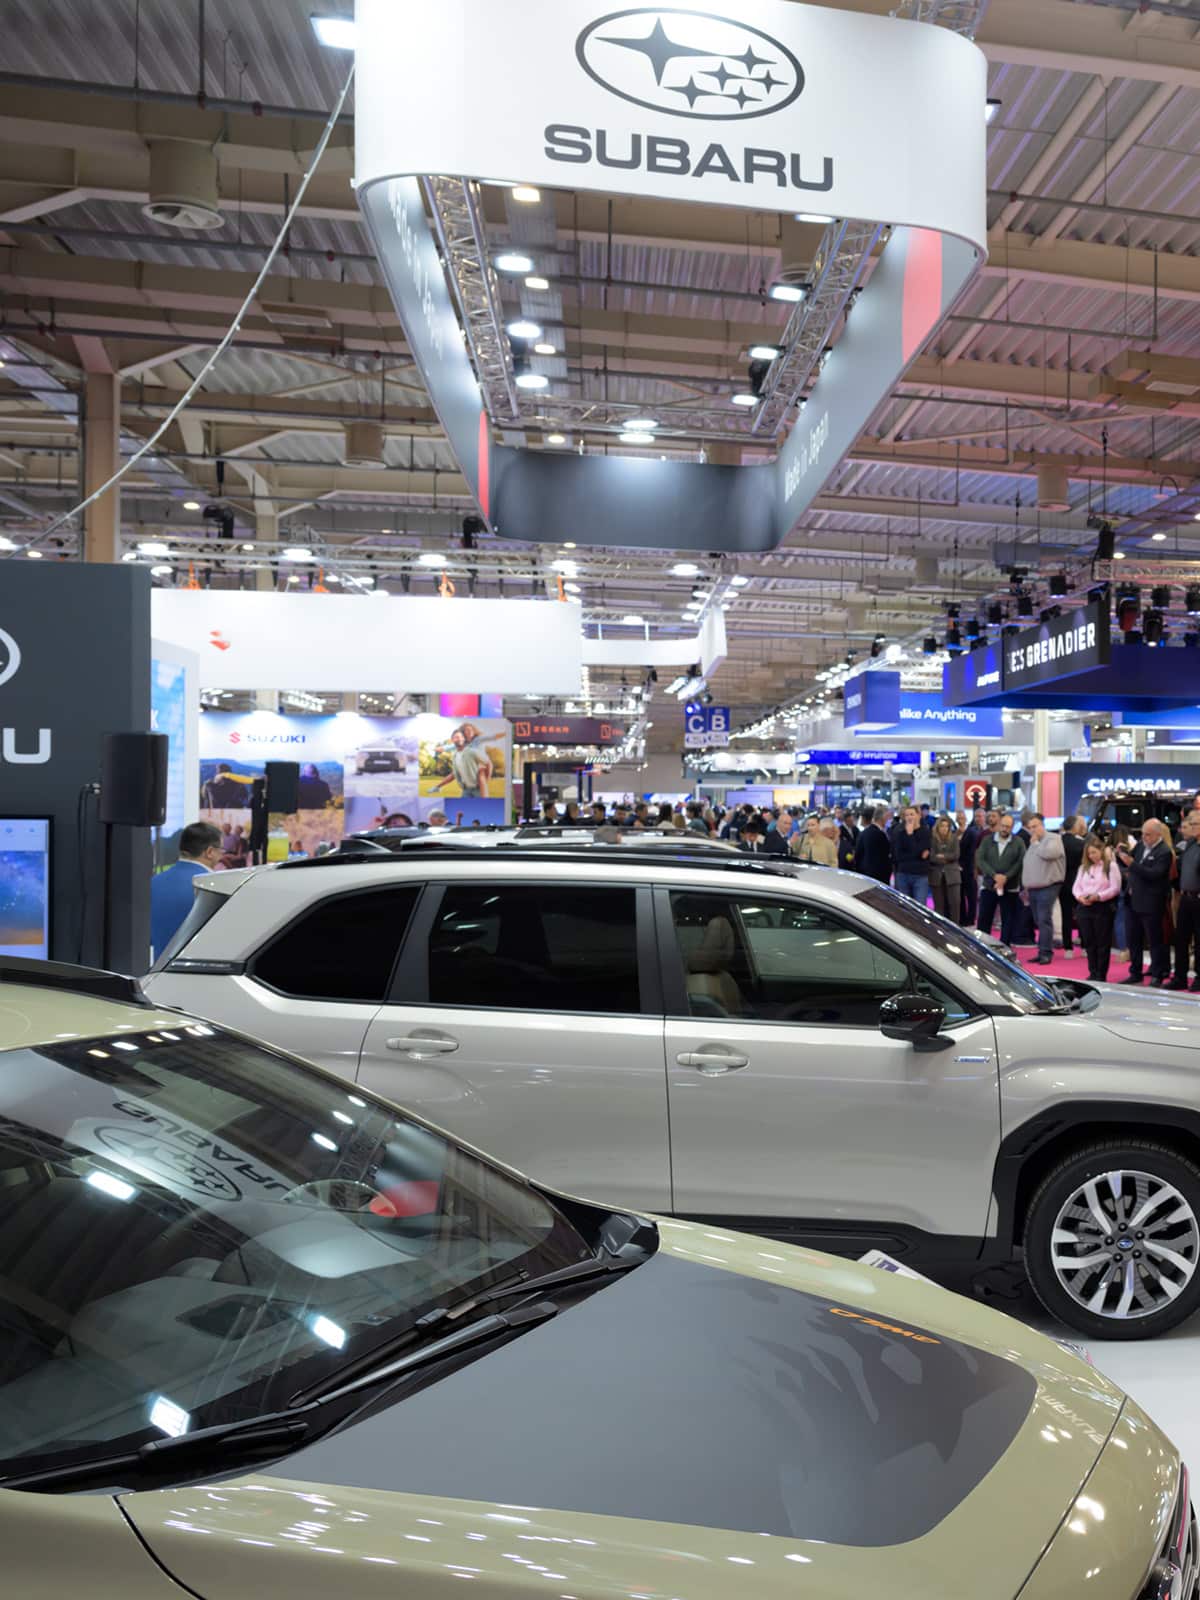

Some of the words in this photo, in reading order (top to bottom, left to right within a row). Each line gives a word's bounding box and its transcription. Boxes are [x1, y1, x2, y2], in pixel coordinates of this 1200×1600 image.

[542, 123, 834, 193] SUBARU
[1026, 622, 1096, 668] GRENADIER
[688, 715, 704, 732] C
[712, 714, 726, 731] B
[923, 708, 976, 722] Anything
[247, 734, 306, 743] SUZUKI
[1087, 778, 1181, 792] CHANGAN
